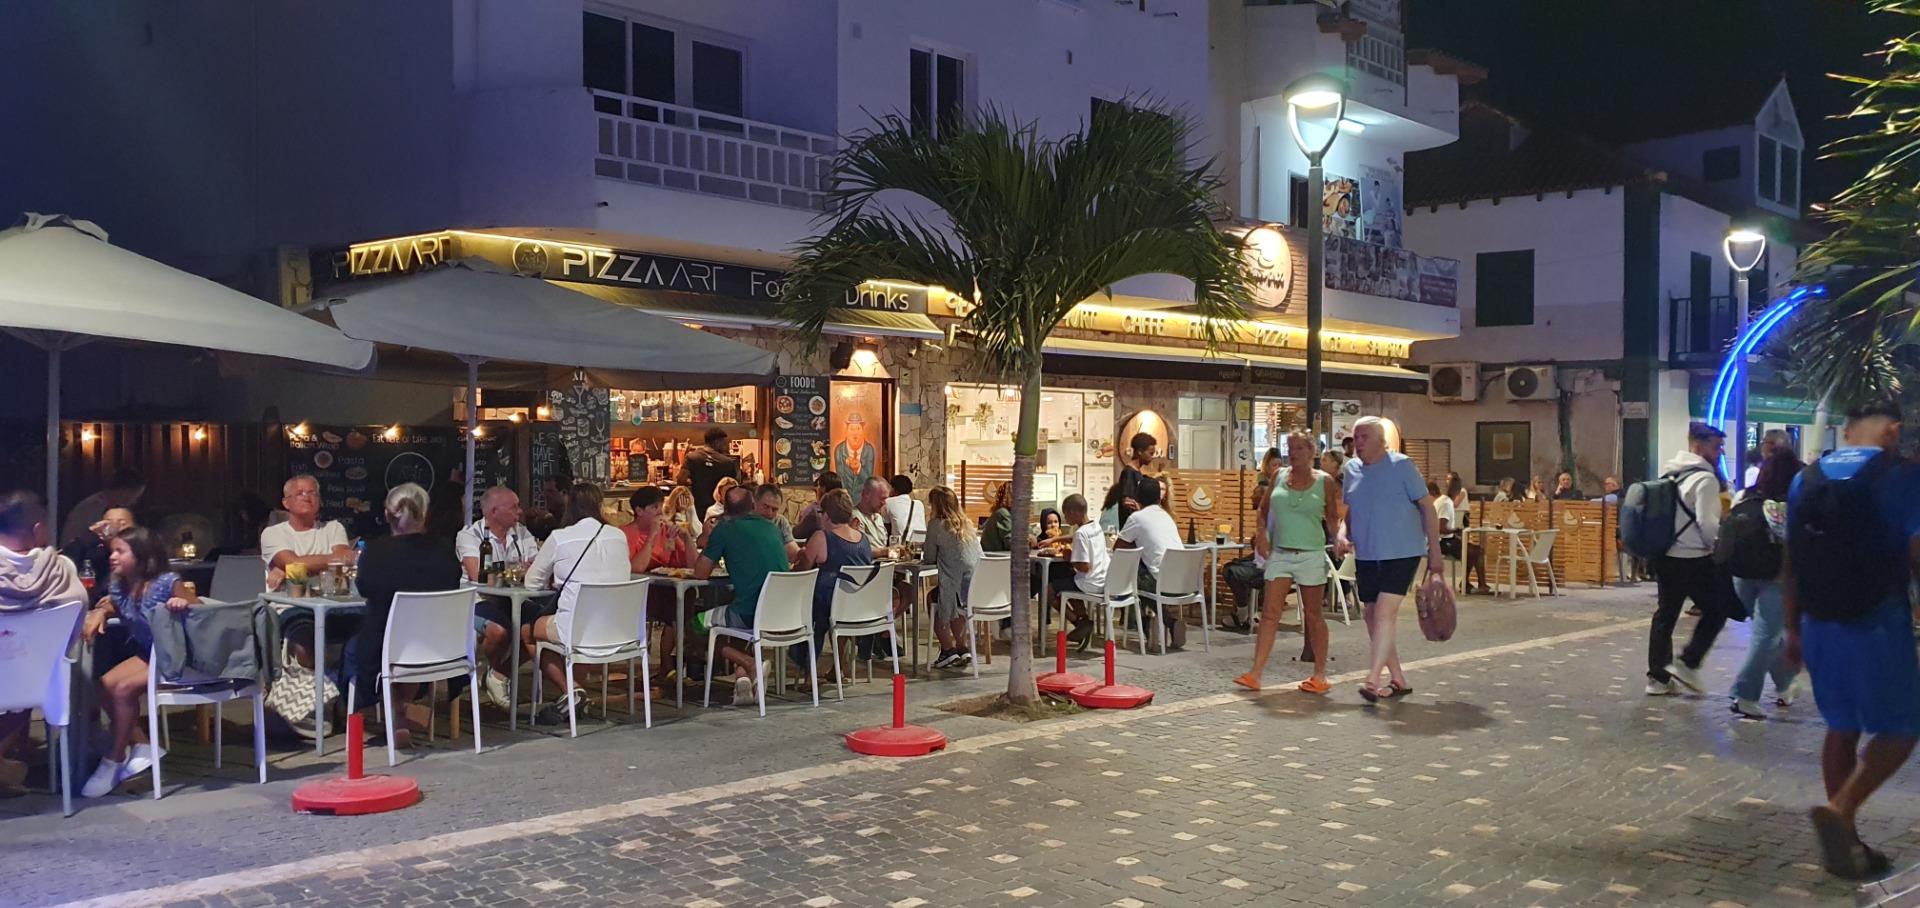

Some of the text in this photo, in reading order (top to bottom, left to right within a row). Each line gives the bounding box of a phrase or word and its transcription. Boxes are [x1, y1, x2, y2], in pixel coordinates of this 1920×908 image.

[845, 284, 910, 311] Drinks
[1254, 328, 1290, 347] PIZZA
[790, 376, 811, 389] FOOD
[372, 433, 384, 443] Eat
[532, 431, 547, 447] WE
[337, 456, 365, 465] Pasta
[532, 446, 555, 463] HAVE
[532, 461, 553, 476] WIFI
